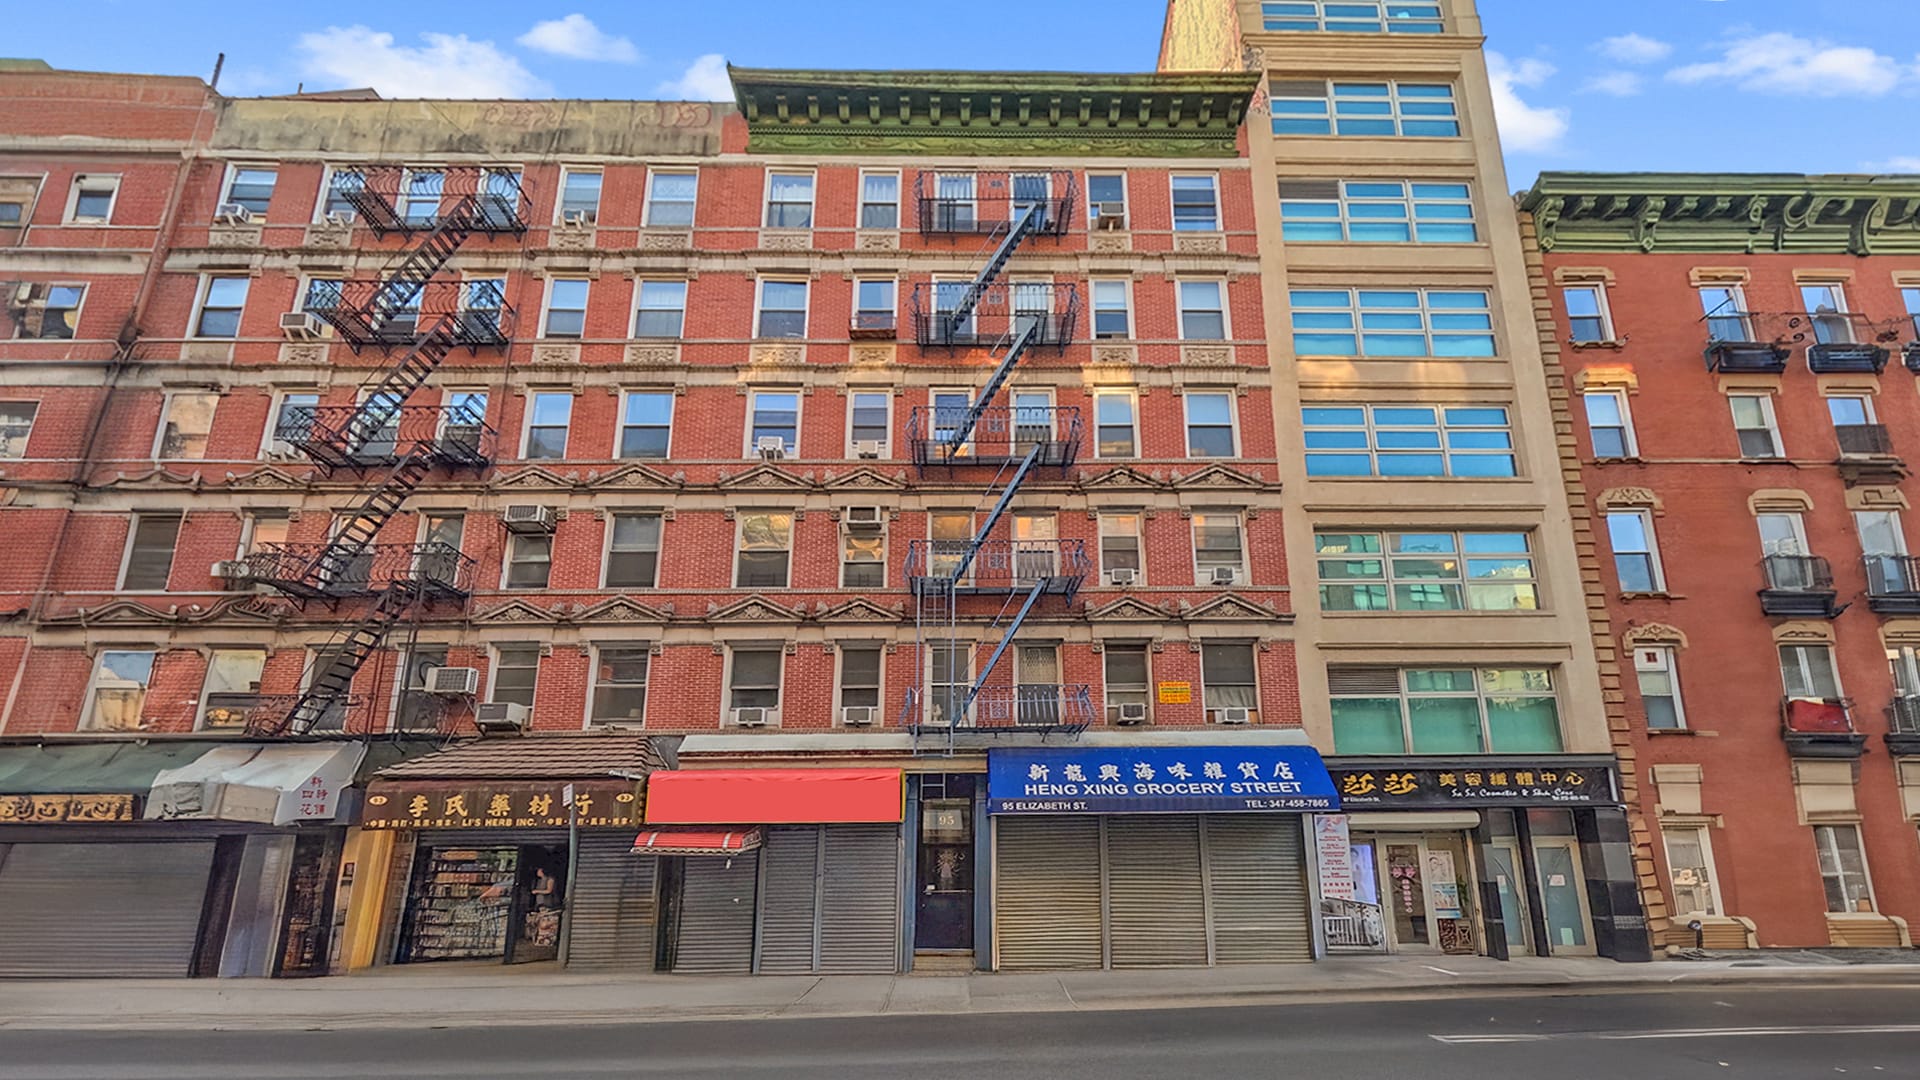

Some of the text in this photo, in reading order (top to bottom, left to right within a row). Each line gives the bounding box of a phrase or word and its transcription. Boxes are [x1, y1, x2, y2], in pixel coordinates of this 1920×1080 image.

[1028, 761, 1294, 782] 新龍興海味雜貨店
[1025, 782, 1301, 795] HENG XING GROCERY STREET
[408, 793, 594, 818] 李氏藥材行
[1002, 802, 1088, 810] 95 ELIZABETH ST.
[1245, 800, 1267, 808] TEL:
[461, 818, 481, 827] LI'S
[485, 818, 513, 827] HERB
[516, 818, 538, 827] INC.
[939, 815, 955, 826] 95
